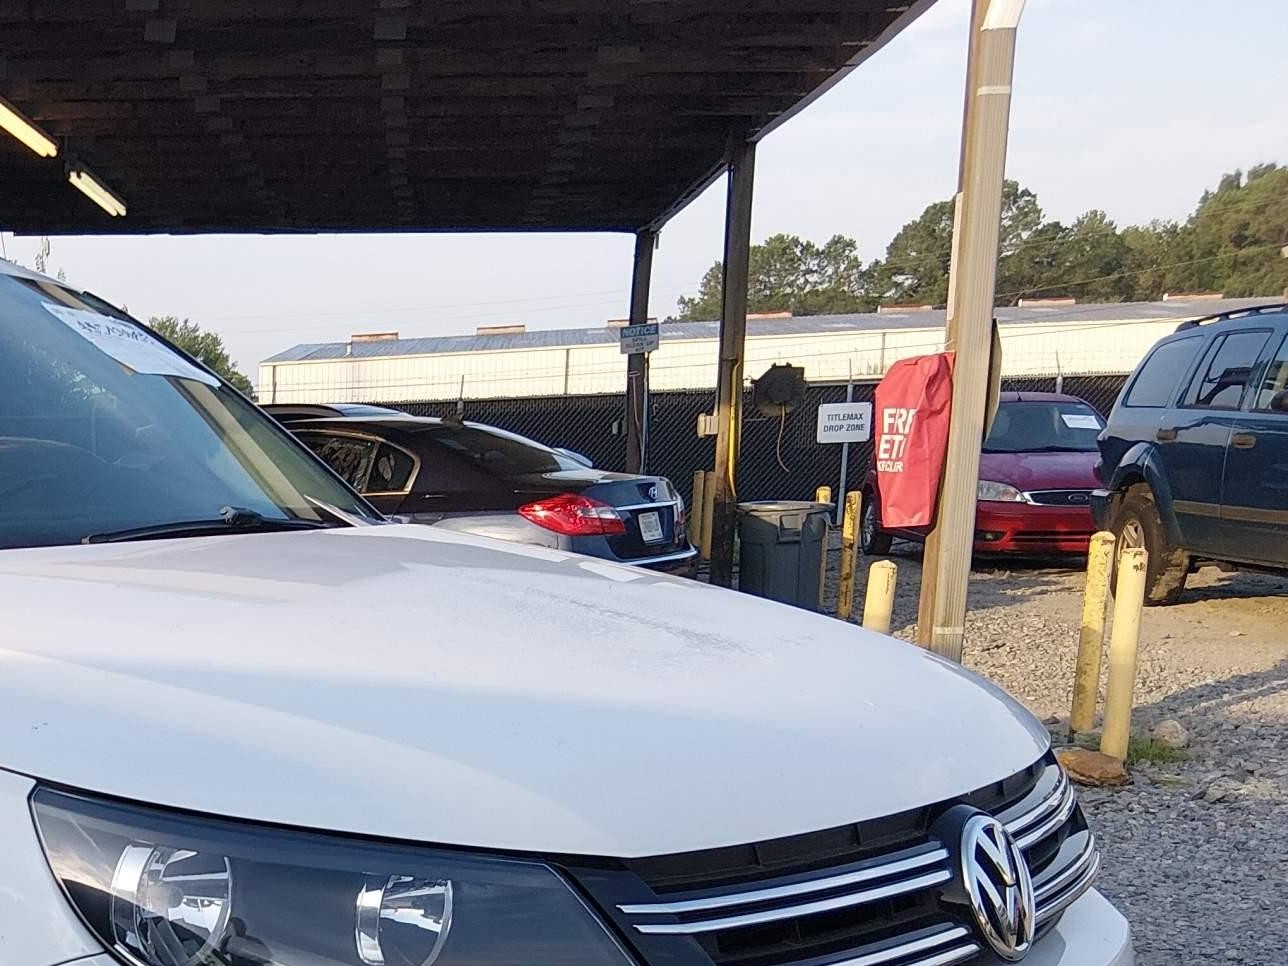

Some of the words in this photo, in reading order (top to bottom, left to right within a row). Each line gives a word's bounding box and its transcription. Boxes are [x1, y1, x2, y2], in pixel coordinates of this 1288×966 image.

[622, 324, 657, 337] NOTICE
[827, 412, 864, 421] TITLEMAX
[823, 424, 845, 432] DROP
[846, 423, 865, 432] ZONE
